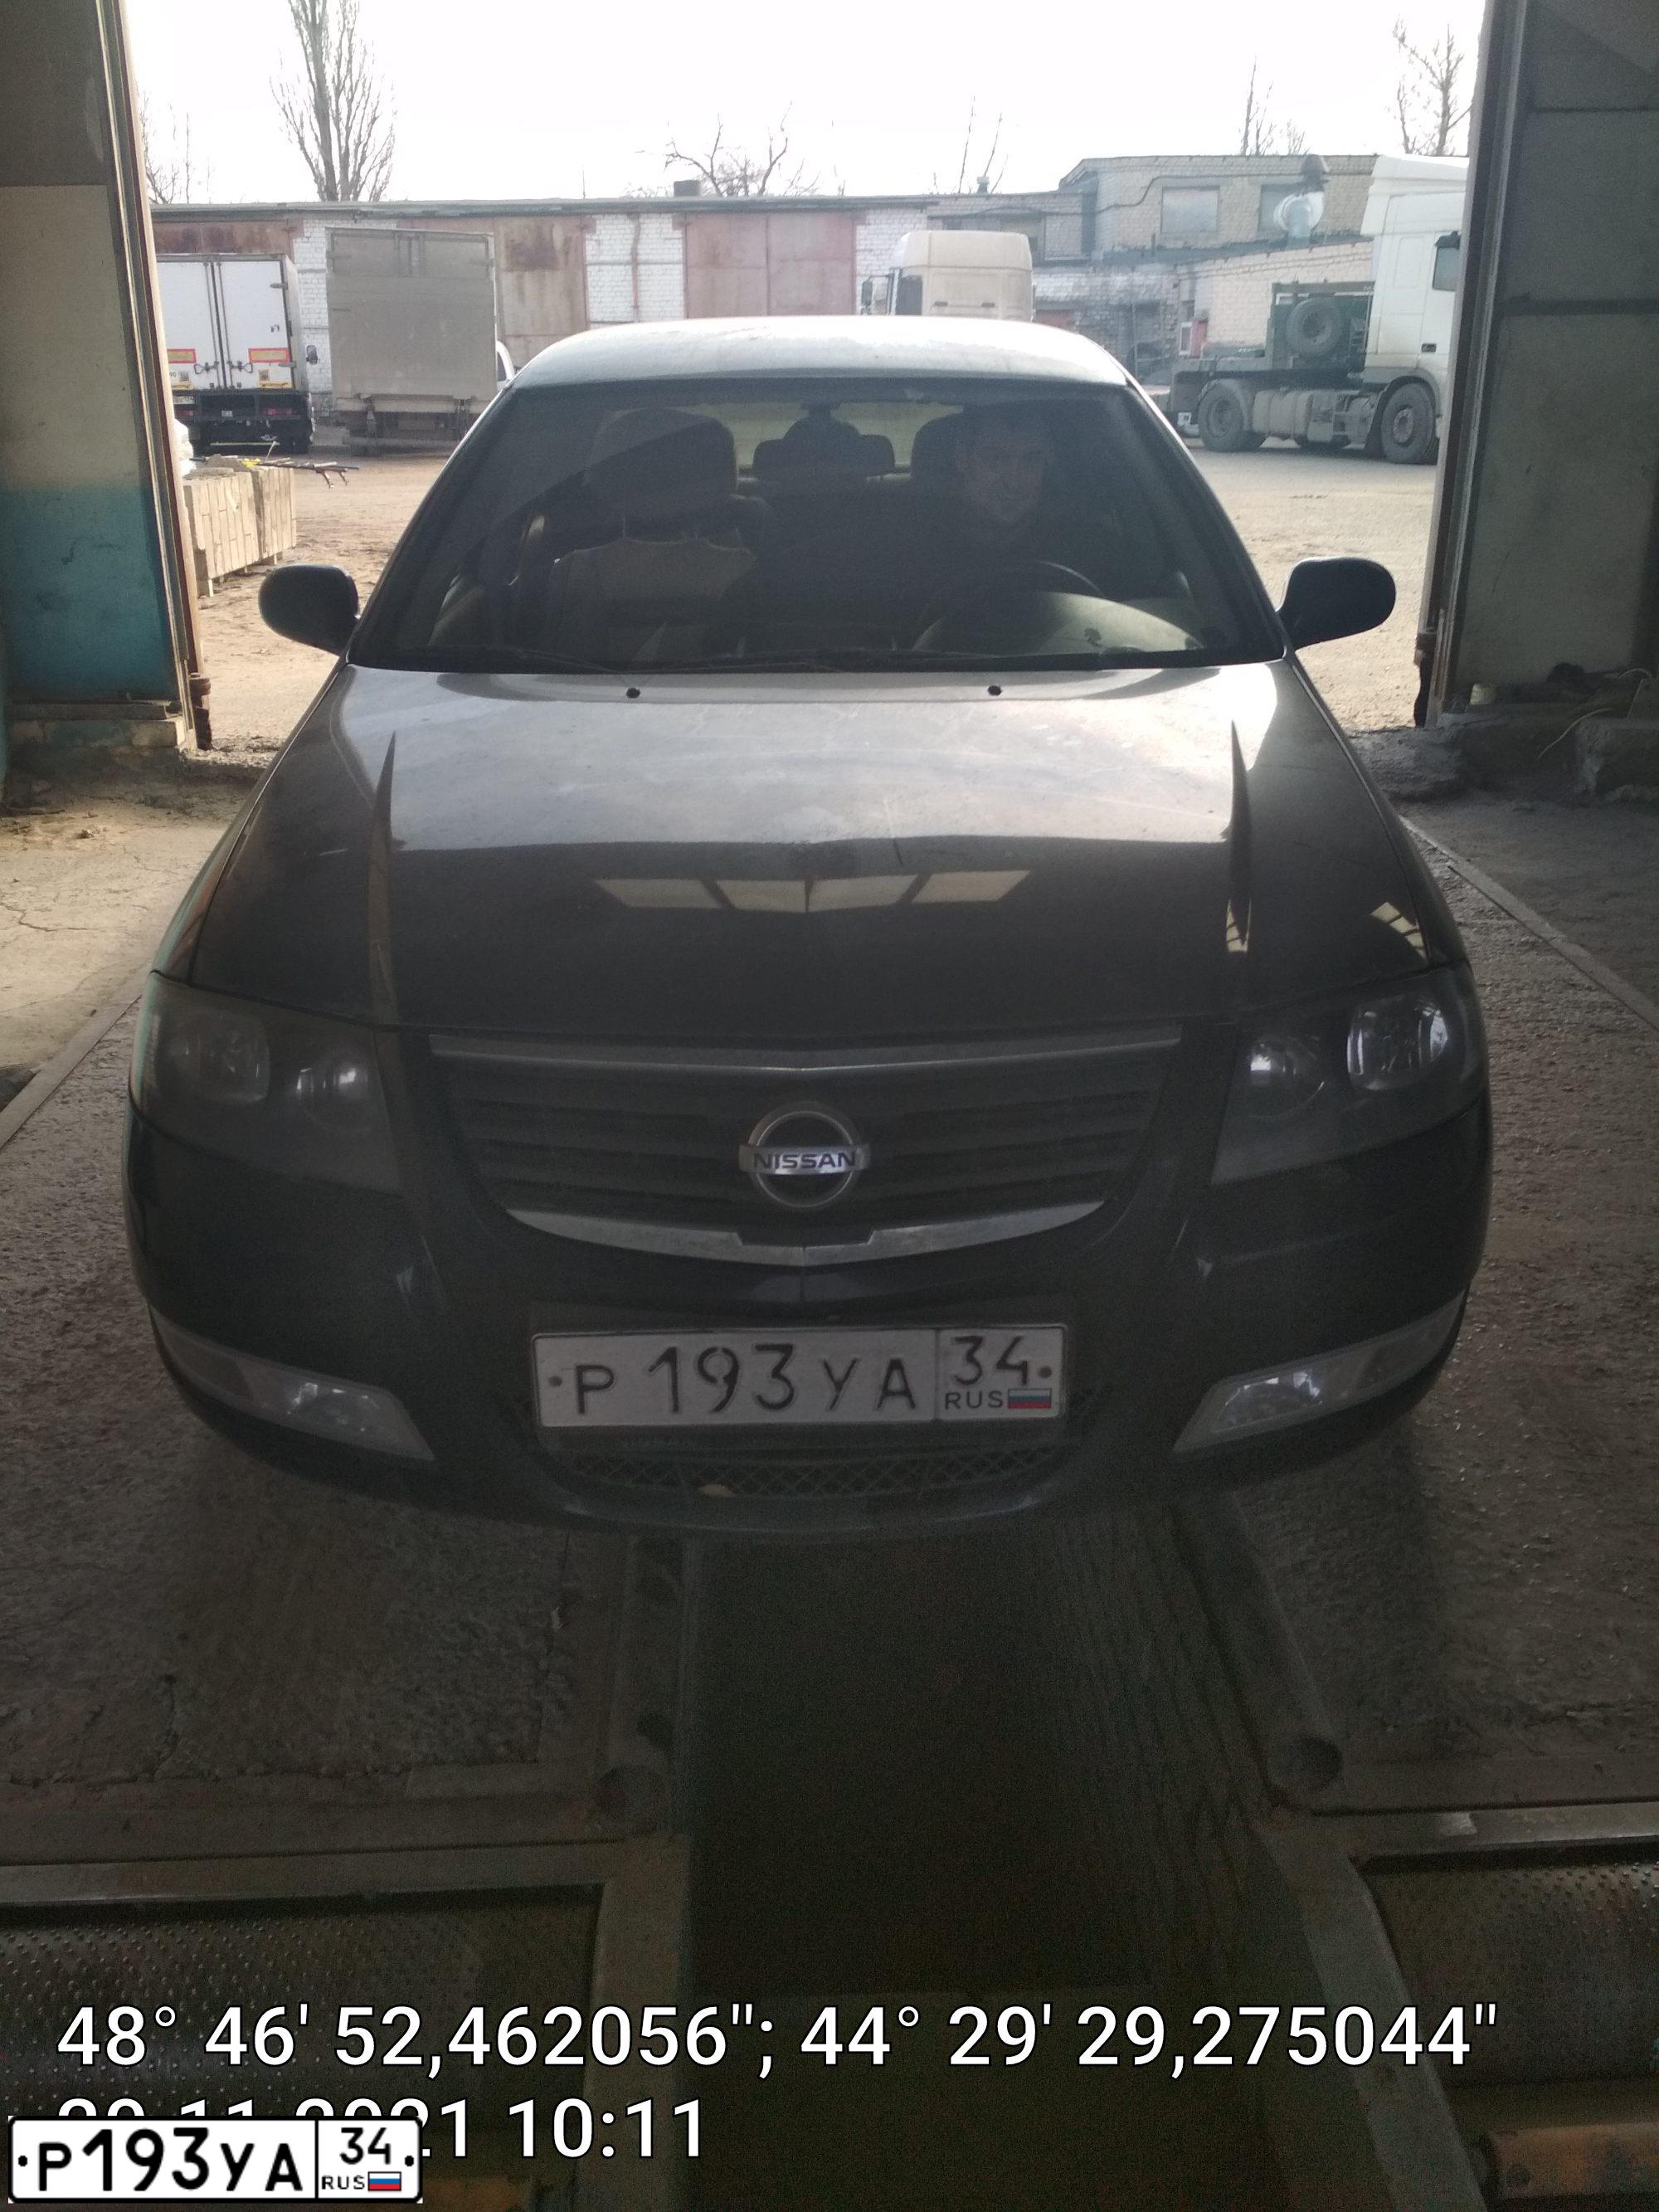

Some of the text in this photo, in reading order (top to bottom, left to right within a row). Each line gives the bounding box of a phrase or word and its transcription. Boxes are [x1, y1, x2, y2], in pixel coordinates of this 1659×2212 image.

[752, 1151, 856, 1170] NISSAN
[953, 1335, 1029, 1386] 34
[944, 1391, 1004, 1410] RUS
